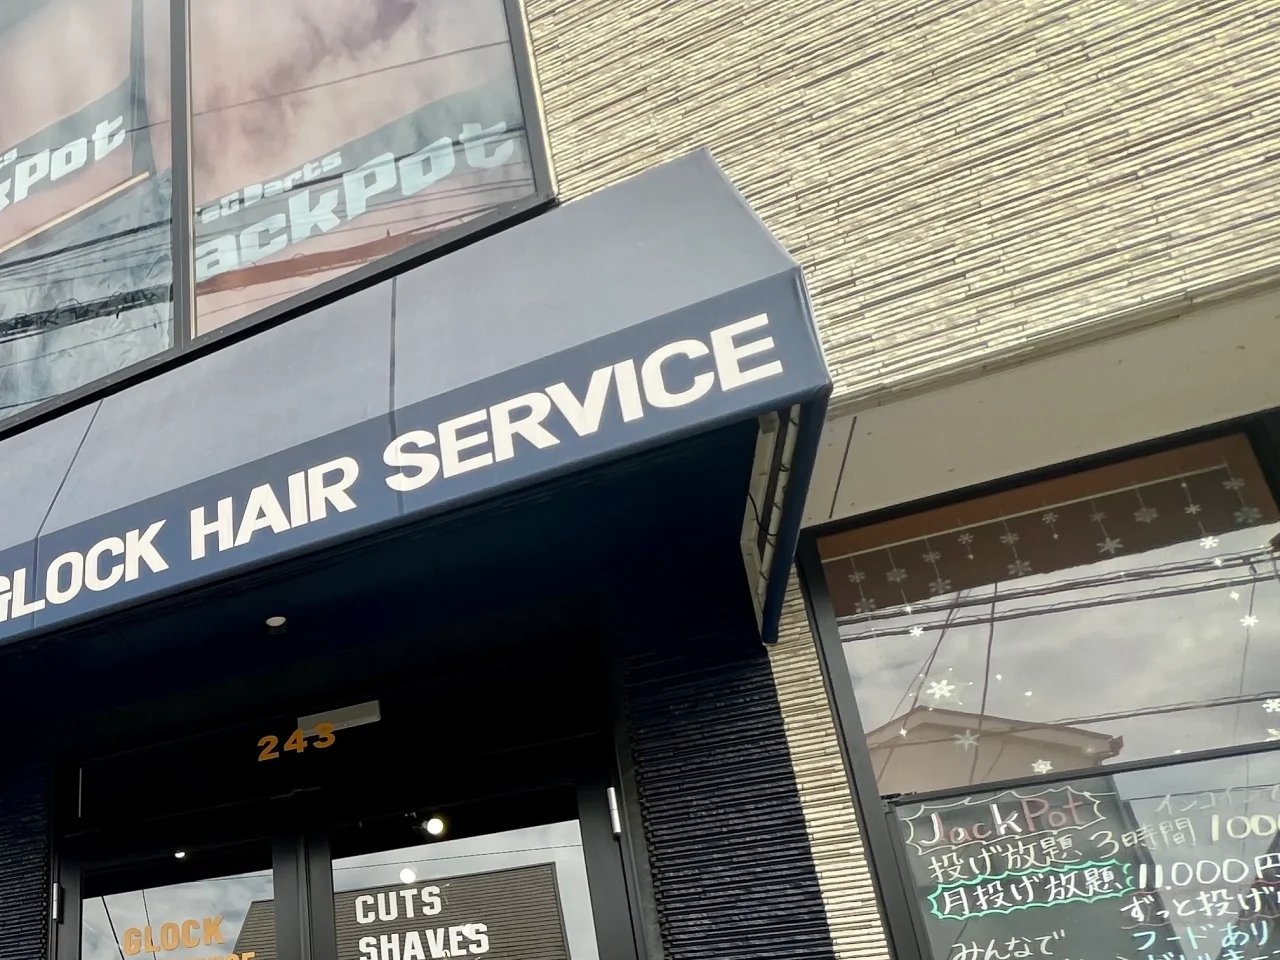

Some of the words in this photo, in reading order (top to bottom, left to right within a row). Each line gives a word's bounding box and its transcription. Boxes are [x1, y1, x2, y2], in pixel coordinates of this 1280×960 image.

[190, 456, 360, 561] HAIR
[382, 312, 783, 492] SERVICE
[257, 722, 336, 762] 243
[920, 790, 1084, 847] JackPot
[927, 833, 1083, 884] 投げ放題
[1211, 814, 1280, 843] 100
[355, 885, 442, 924] CUTS
[943, 864, 1123, 915] 月投げ放題
[1120, 886, 1280, 923] ずっと投げ
[124, 917, 225, 956] GLOCK
